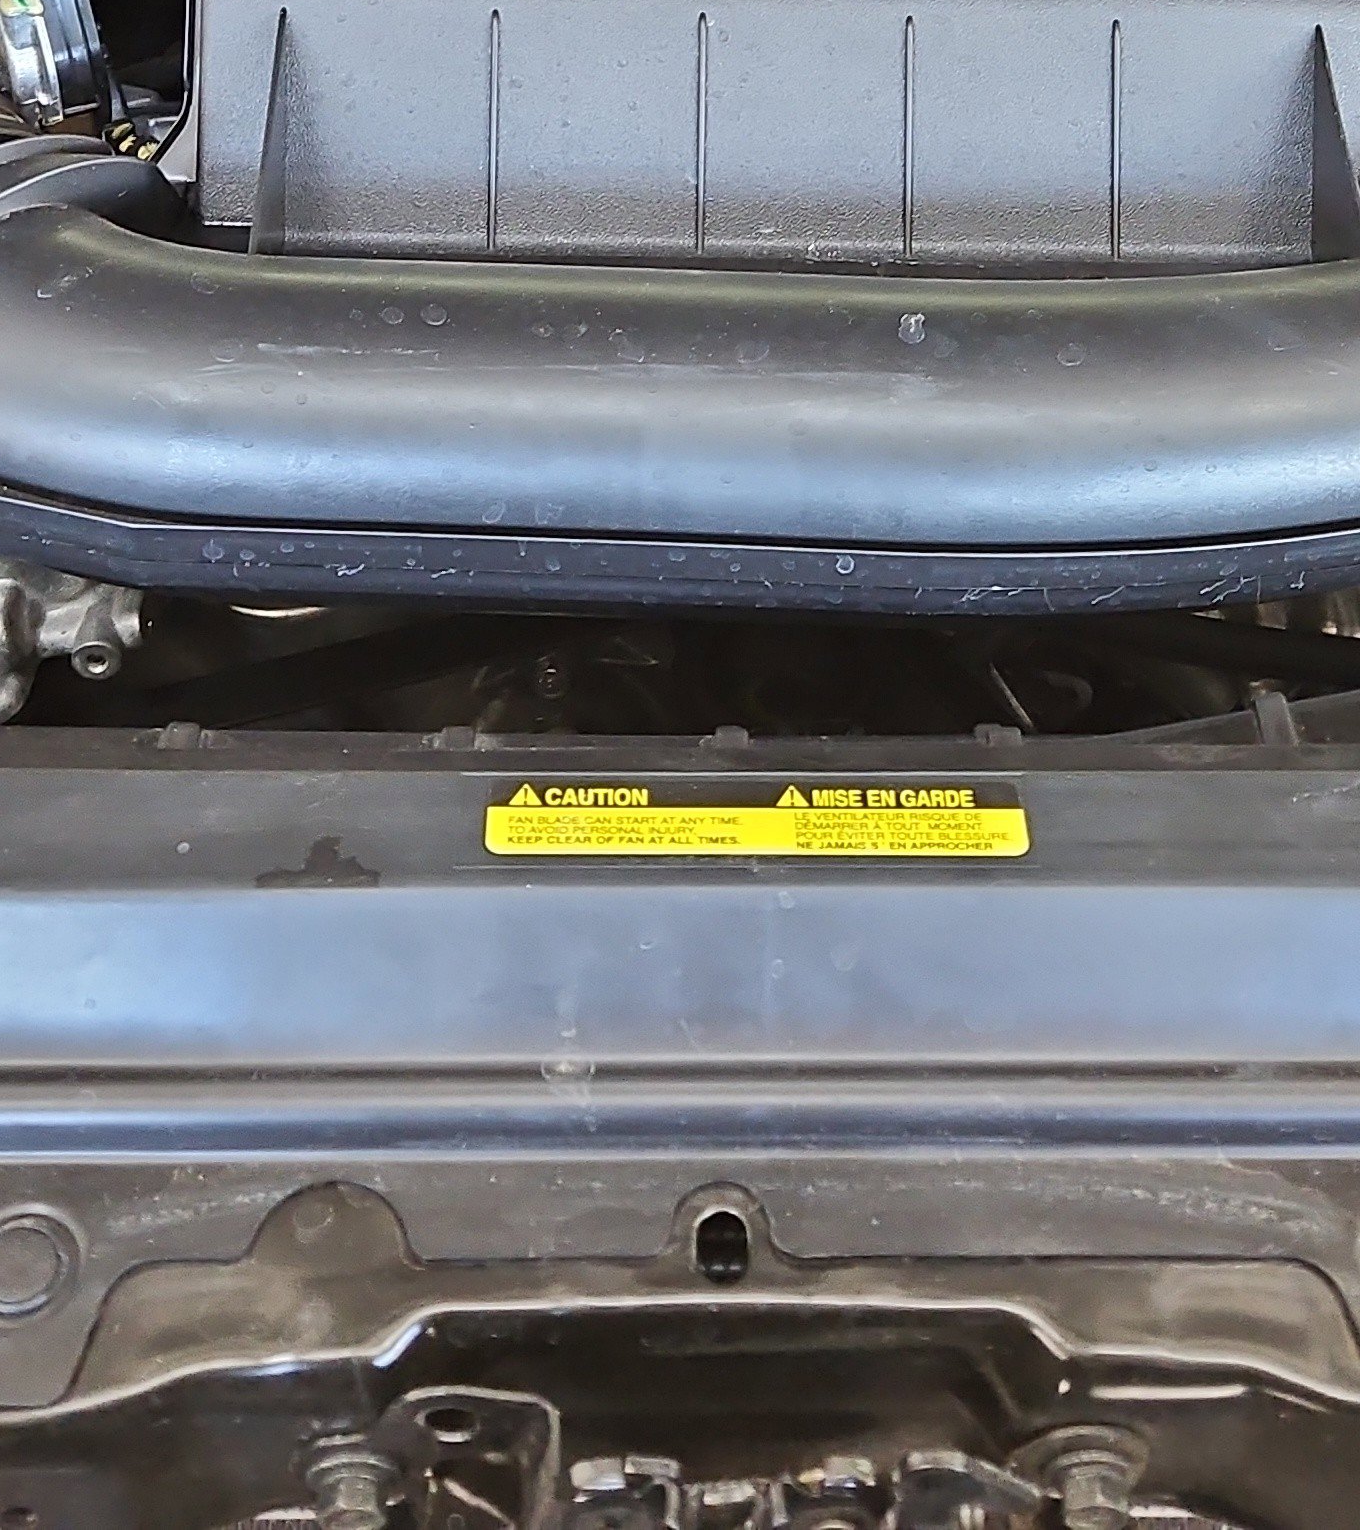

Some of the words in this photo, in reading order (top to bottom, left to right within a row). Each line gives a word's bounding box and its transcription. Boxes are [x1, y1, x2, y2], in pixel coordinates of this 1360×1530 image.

[544, 787, 649, 806] CAUTION
[811, 789, 864, 807] MISE
[866, 789, 898, 807] EN
[899, 789, 977, 808] GARDE
[508, 816, 534, 826] FAN
[537, 816, 580, 826] BLADE
[584, 816, 613, 826] CAN
[615, 816, 657, 826] START
[660, 816, 677, 826] AT
[679, 816, 706, 826] ANY
[794, 812, 811, 821] LE
[813, 812, 905, 821] VENTILATEUR
[908, 812, 960, 821] RISQUE
[965, 812, 982, 821] DE
[508, 826, 526, 835] TO
[529, 826, 569, 835] AVOID
[572, 826, 644, 835] PERSONAL
[886, 822, 920, 830] TOUT
[795, 832, 833, 841] POUR
[837, 830, 885, 841] ÉVITER
[889, 832, 934, 841] TOUTE
[507, 836, 543, 845] KEEP
[546, 836, 592, 845] CLEAR
[596, 836, 615, 845] OF
[618, 836, 646, 845] FAN
[648, 836, 665, 845] AT
[668, 836, 694, 845] ALL
[796, 842, 813, 850] NE
[818, 842, 866, 850] JAMAIS
[910, 842, 993, 851] APPROCHER
